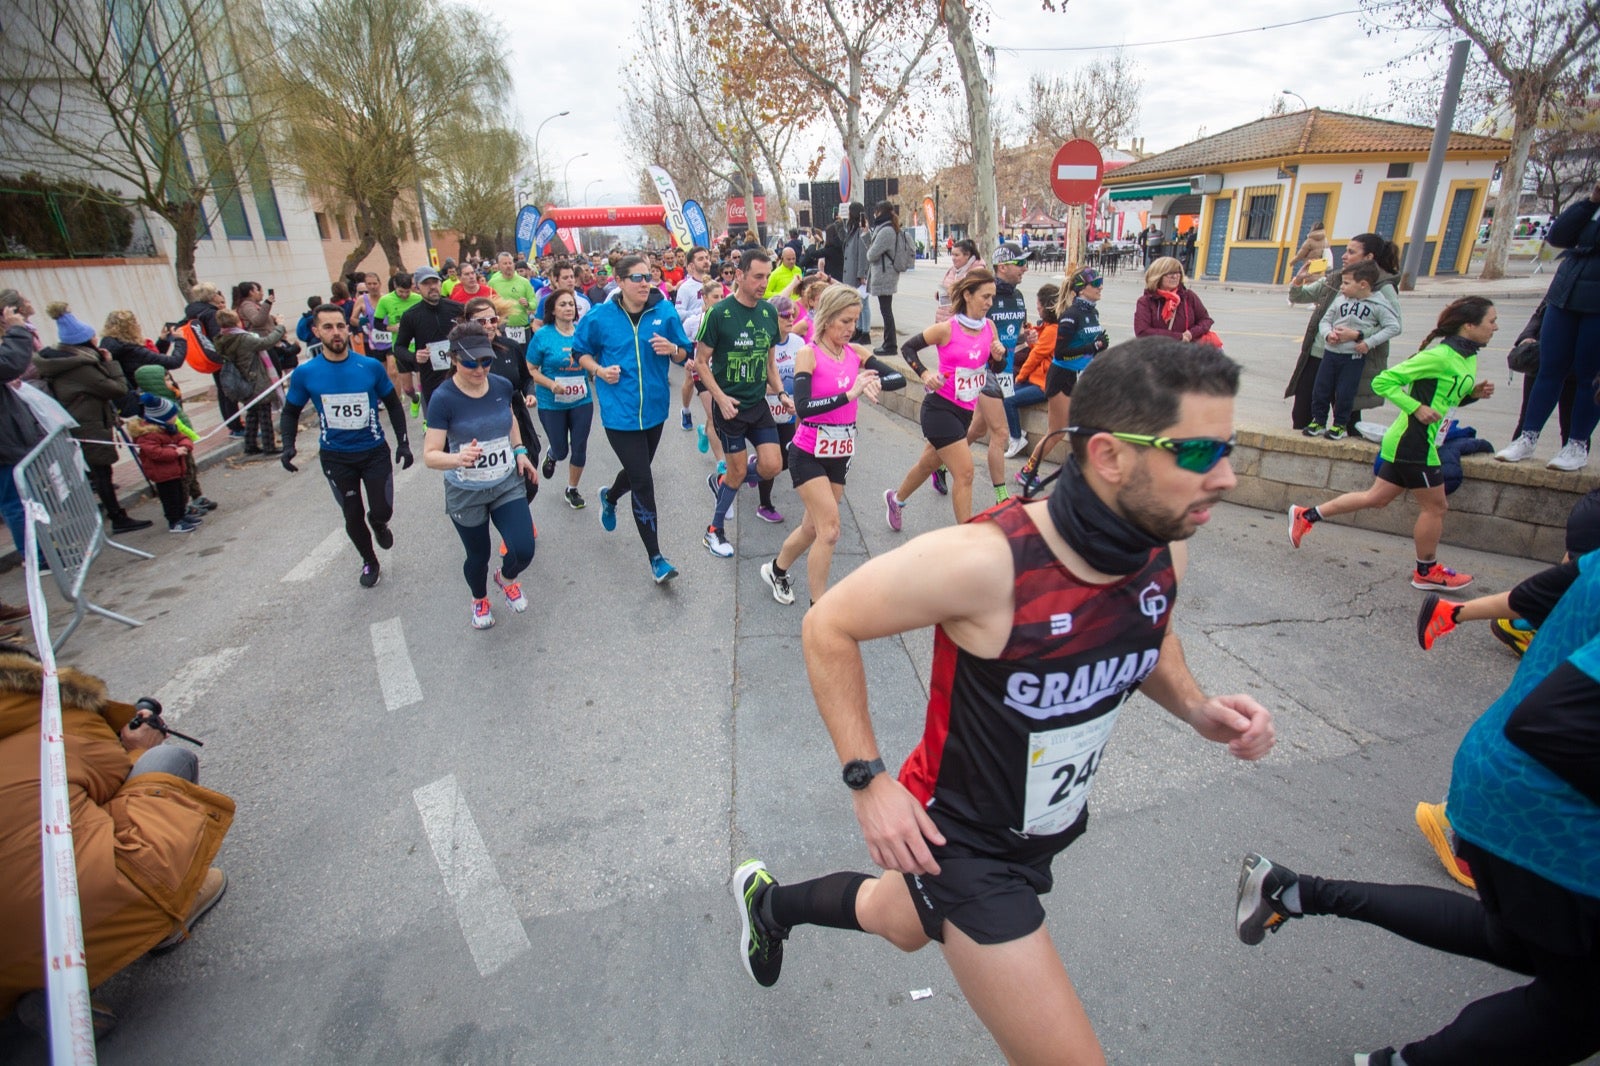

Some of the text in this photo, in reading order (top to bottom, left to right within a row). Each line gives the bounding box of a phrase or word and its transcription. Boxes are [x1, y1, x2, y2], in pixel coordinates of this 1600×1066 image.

[1340, 302, 1371, 320] GAP
[957, 374, 985, 390] 2110
[331, 403, 363, 418] 785
[818, 438, 853, 455] 2156
[465, 449, 507, 469] 201
